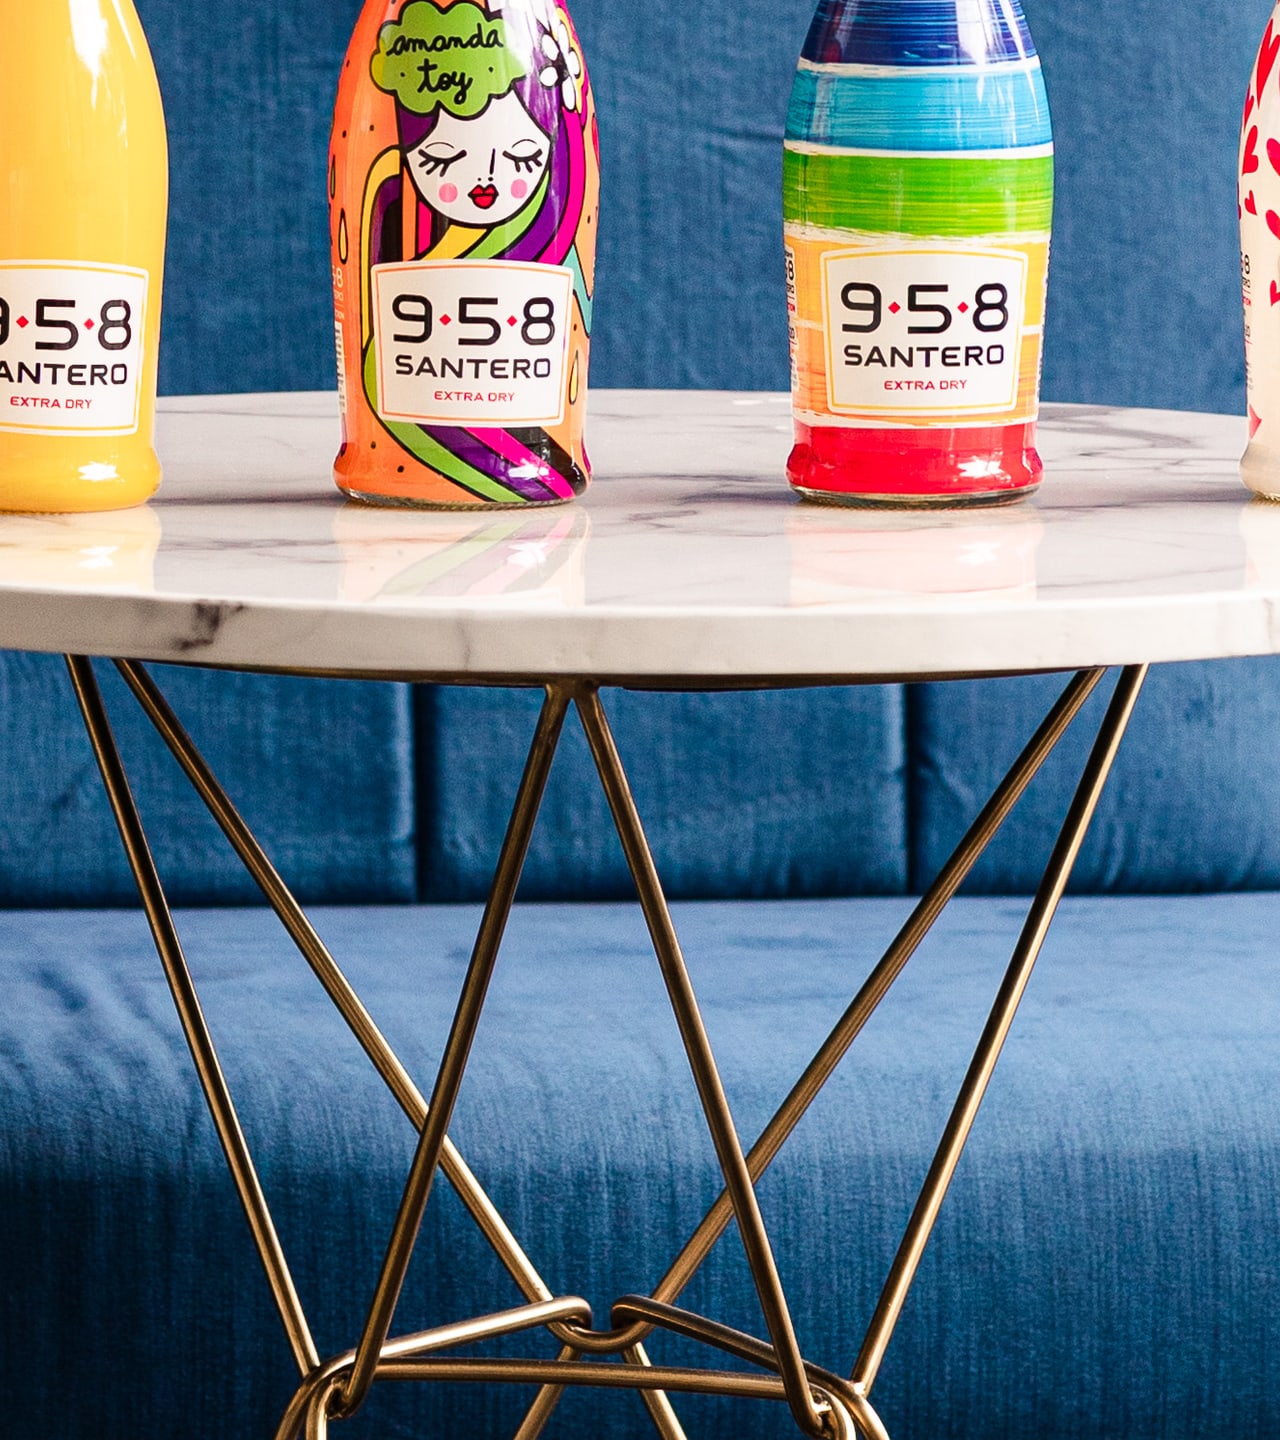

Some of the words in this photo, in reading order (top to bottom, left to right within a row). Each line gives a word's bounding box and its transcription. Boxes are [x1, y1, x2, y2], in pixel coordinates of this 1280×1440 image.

[386, 22, 504, 56] amanda
[417, 58, 473, 105] toy
[395, 354, 551, 379] SANTERO
[843, 344, 1004, 368] SANTERO
[434, 390, 484, 402] EXTRA
[488, 392, 515, 402] DRY
[884, 380, 935, 390] EXTRA
[939, 379, 968, 390] DRY
[10, 396, 61, 409] EXTRA
[65, 399, 92, 409] DRY
